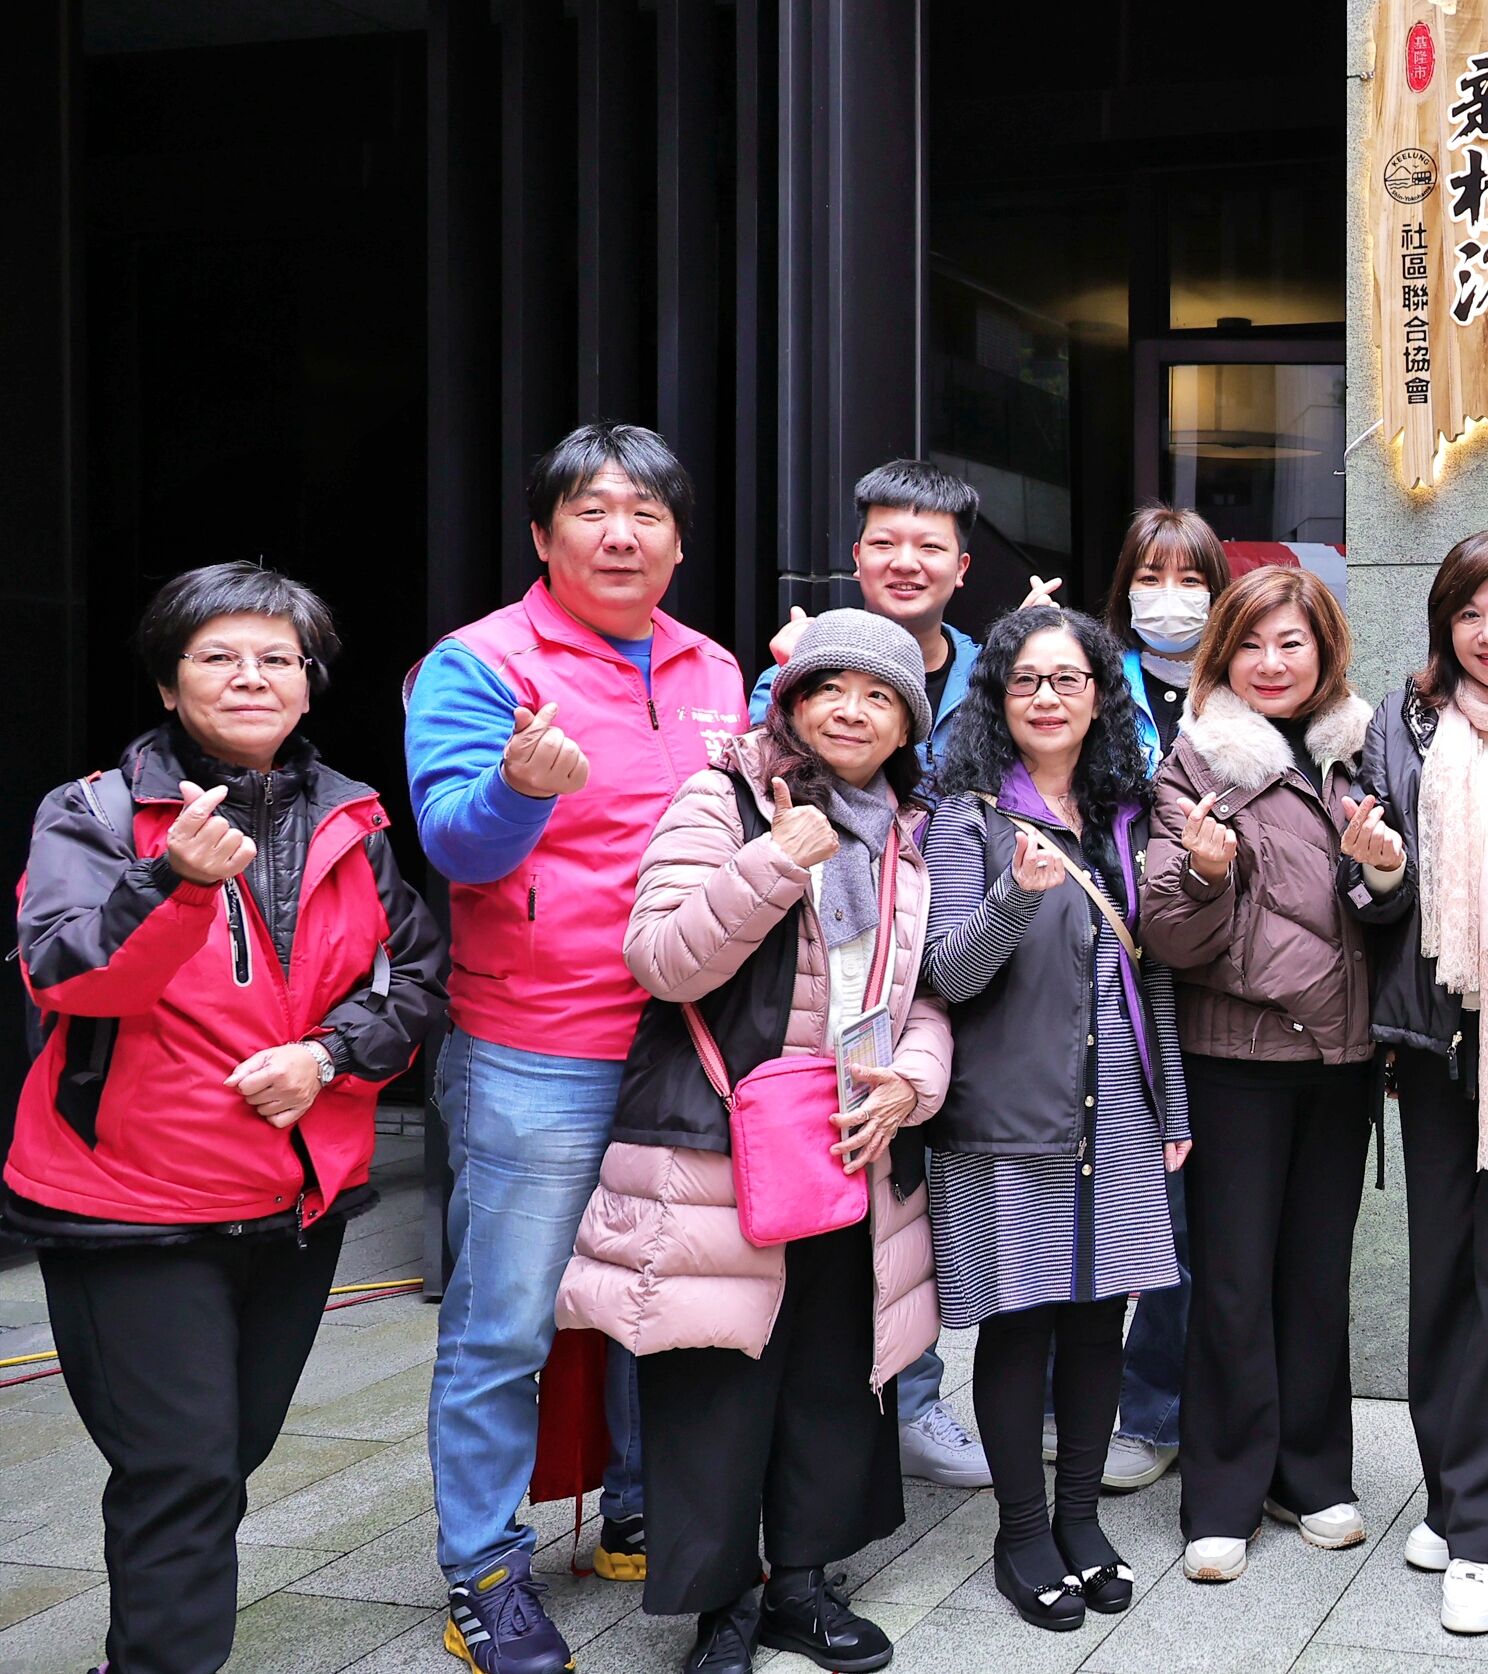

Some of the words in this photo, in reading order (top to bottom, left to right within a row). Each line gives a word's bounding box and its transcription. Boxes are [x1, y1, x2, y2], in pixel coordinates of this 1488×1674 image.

[1413, 35, 1428, 80] 基隆市
[1391, 151, 1430, 168] KEELUNG
[1401, 222, 1430, 404] 社區聯合協會
